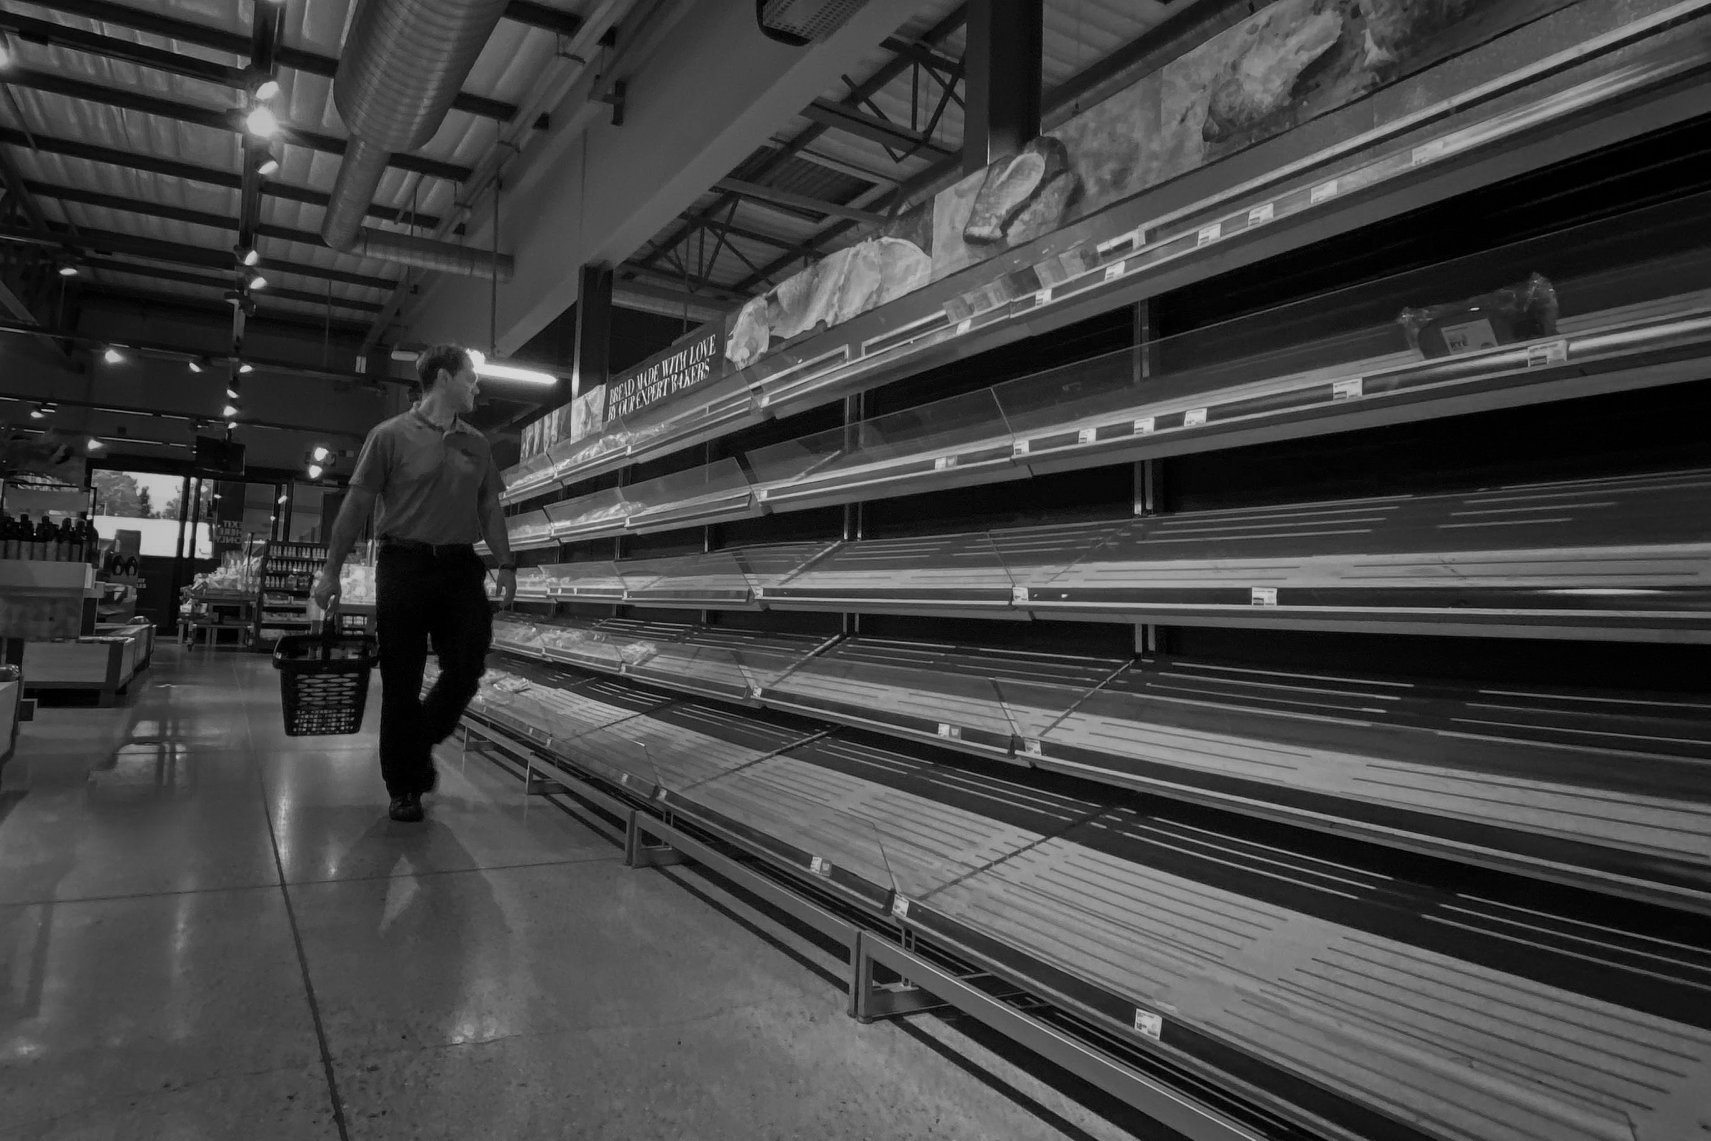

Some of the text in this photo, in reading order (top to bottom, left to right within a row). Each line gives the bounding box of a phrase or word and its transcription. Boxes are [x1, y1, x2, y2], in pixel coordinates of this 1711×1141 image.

[608, 358, 710, 422] BY OUR EXPERT BAKERS
[610, 334, 716, 405] BREAD MADE WITH LOVE
